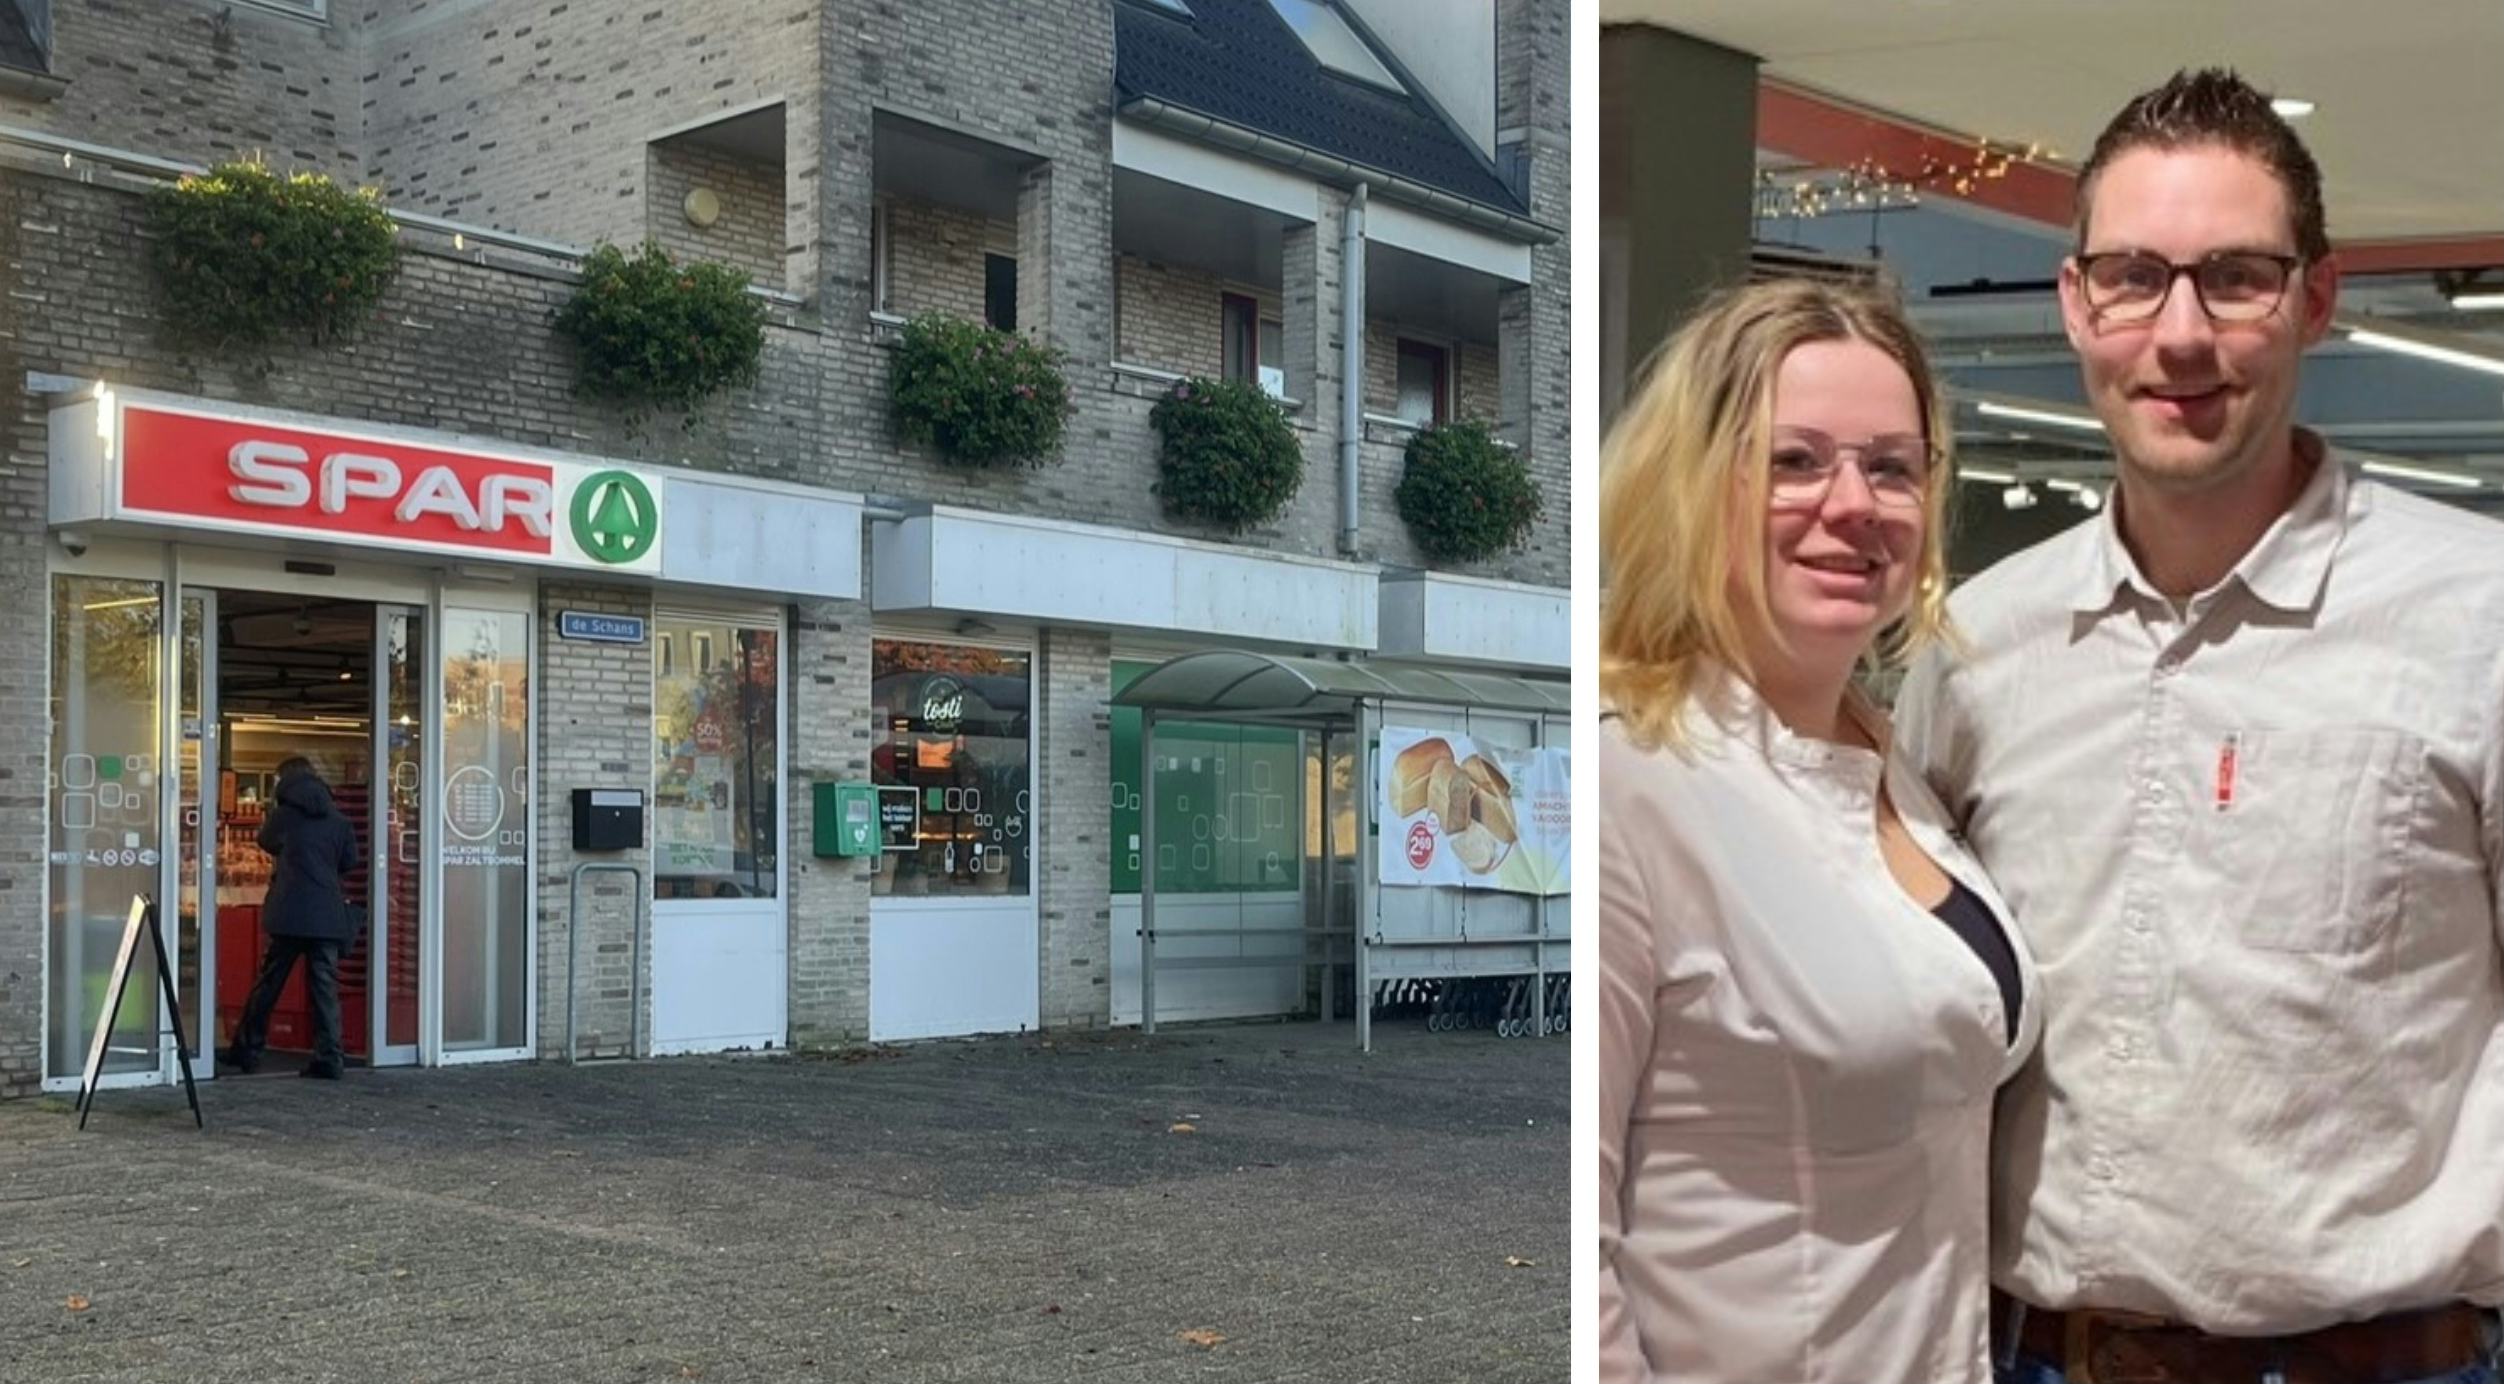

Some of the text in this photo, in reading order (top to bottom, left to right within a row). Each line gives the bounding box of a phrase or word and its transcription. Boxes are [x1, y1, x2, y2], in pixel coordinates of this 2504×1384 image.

[229, 440, 551, 537] SPAR
[572, 619, 634, 636] de Schans
[923, 695, 963, 721] tosti
[697, 722, 722, 738] 50%
